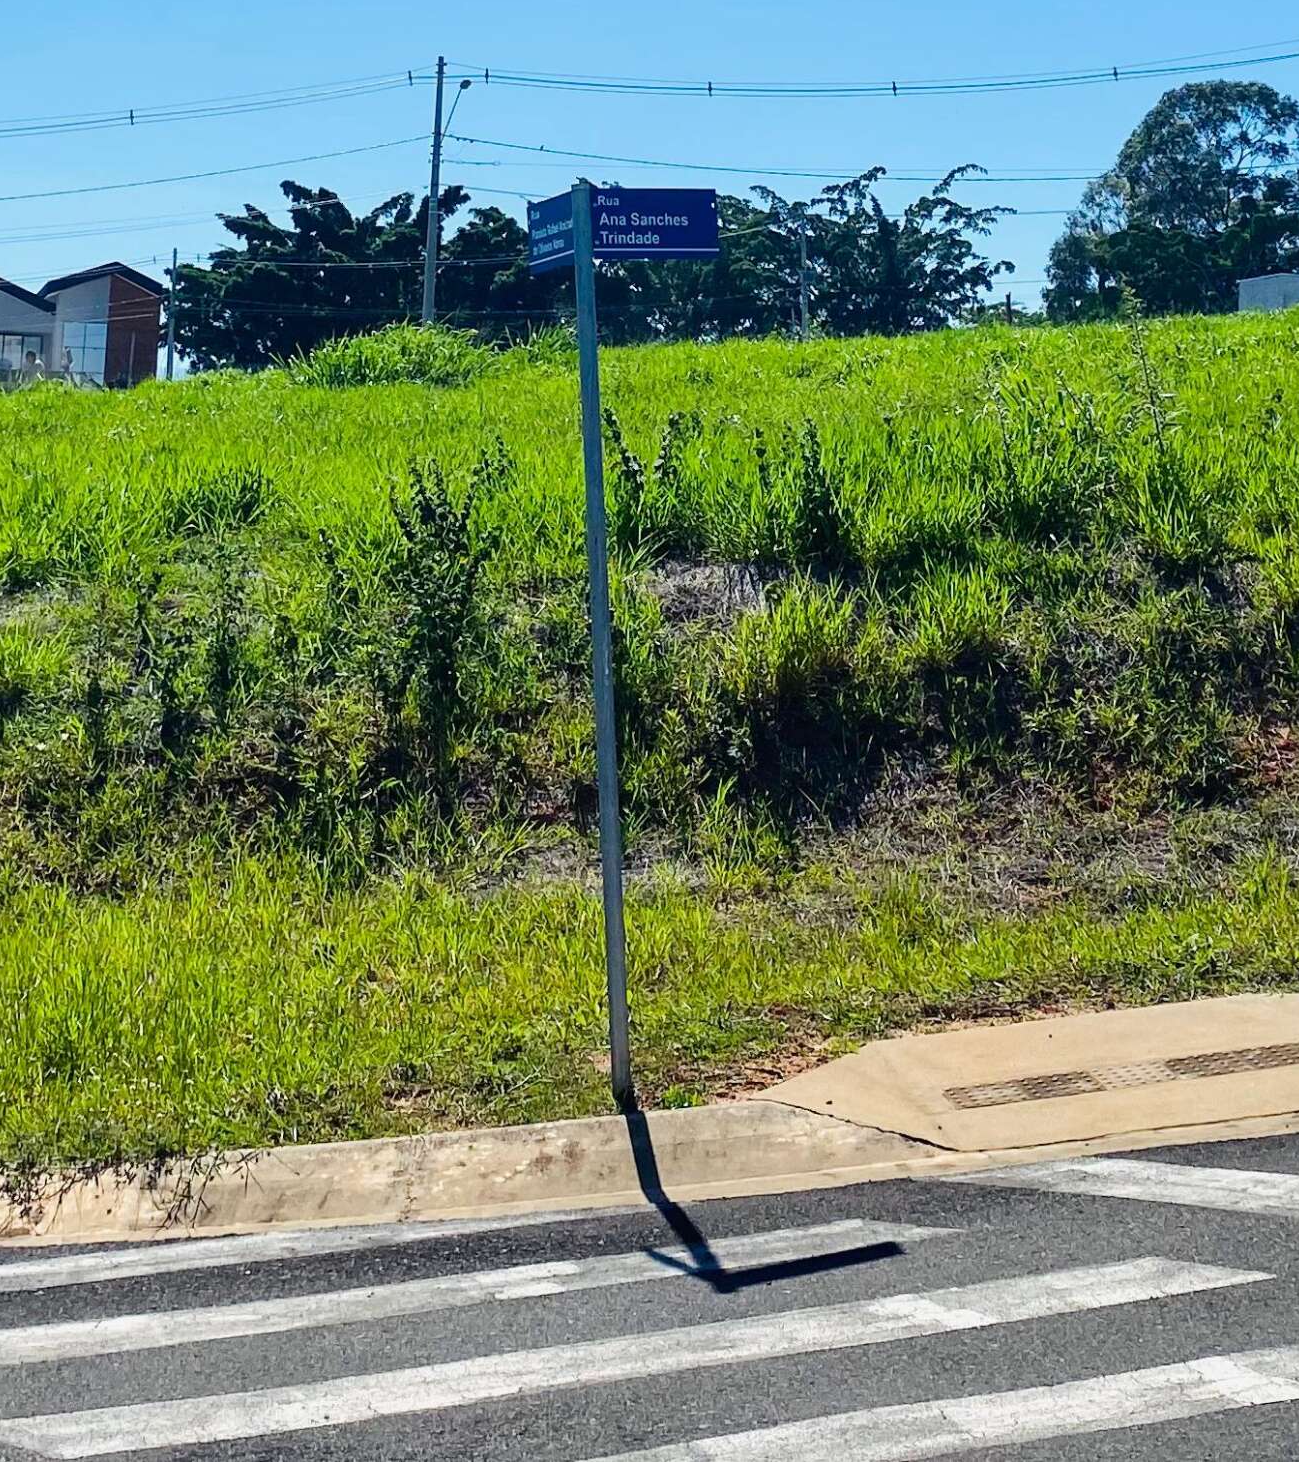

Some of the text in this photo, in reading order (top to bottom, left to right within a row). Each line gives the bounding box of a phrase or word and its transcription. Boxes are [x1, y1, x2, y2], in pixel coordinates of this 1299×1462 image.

[597, 195, 620, 206] Rua
[599, 212, 689, 226] Ana Sanches
[599, 231, 660, 245] Trindade
